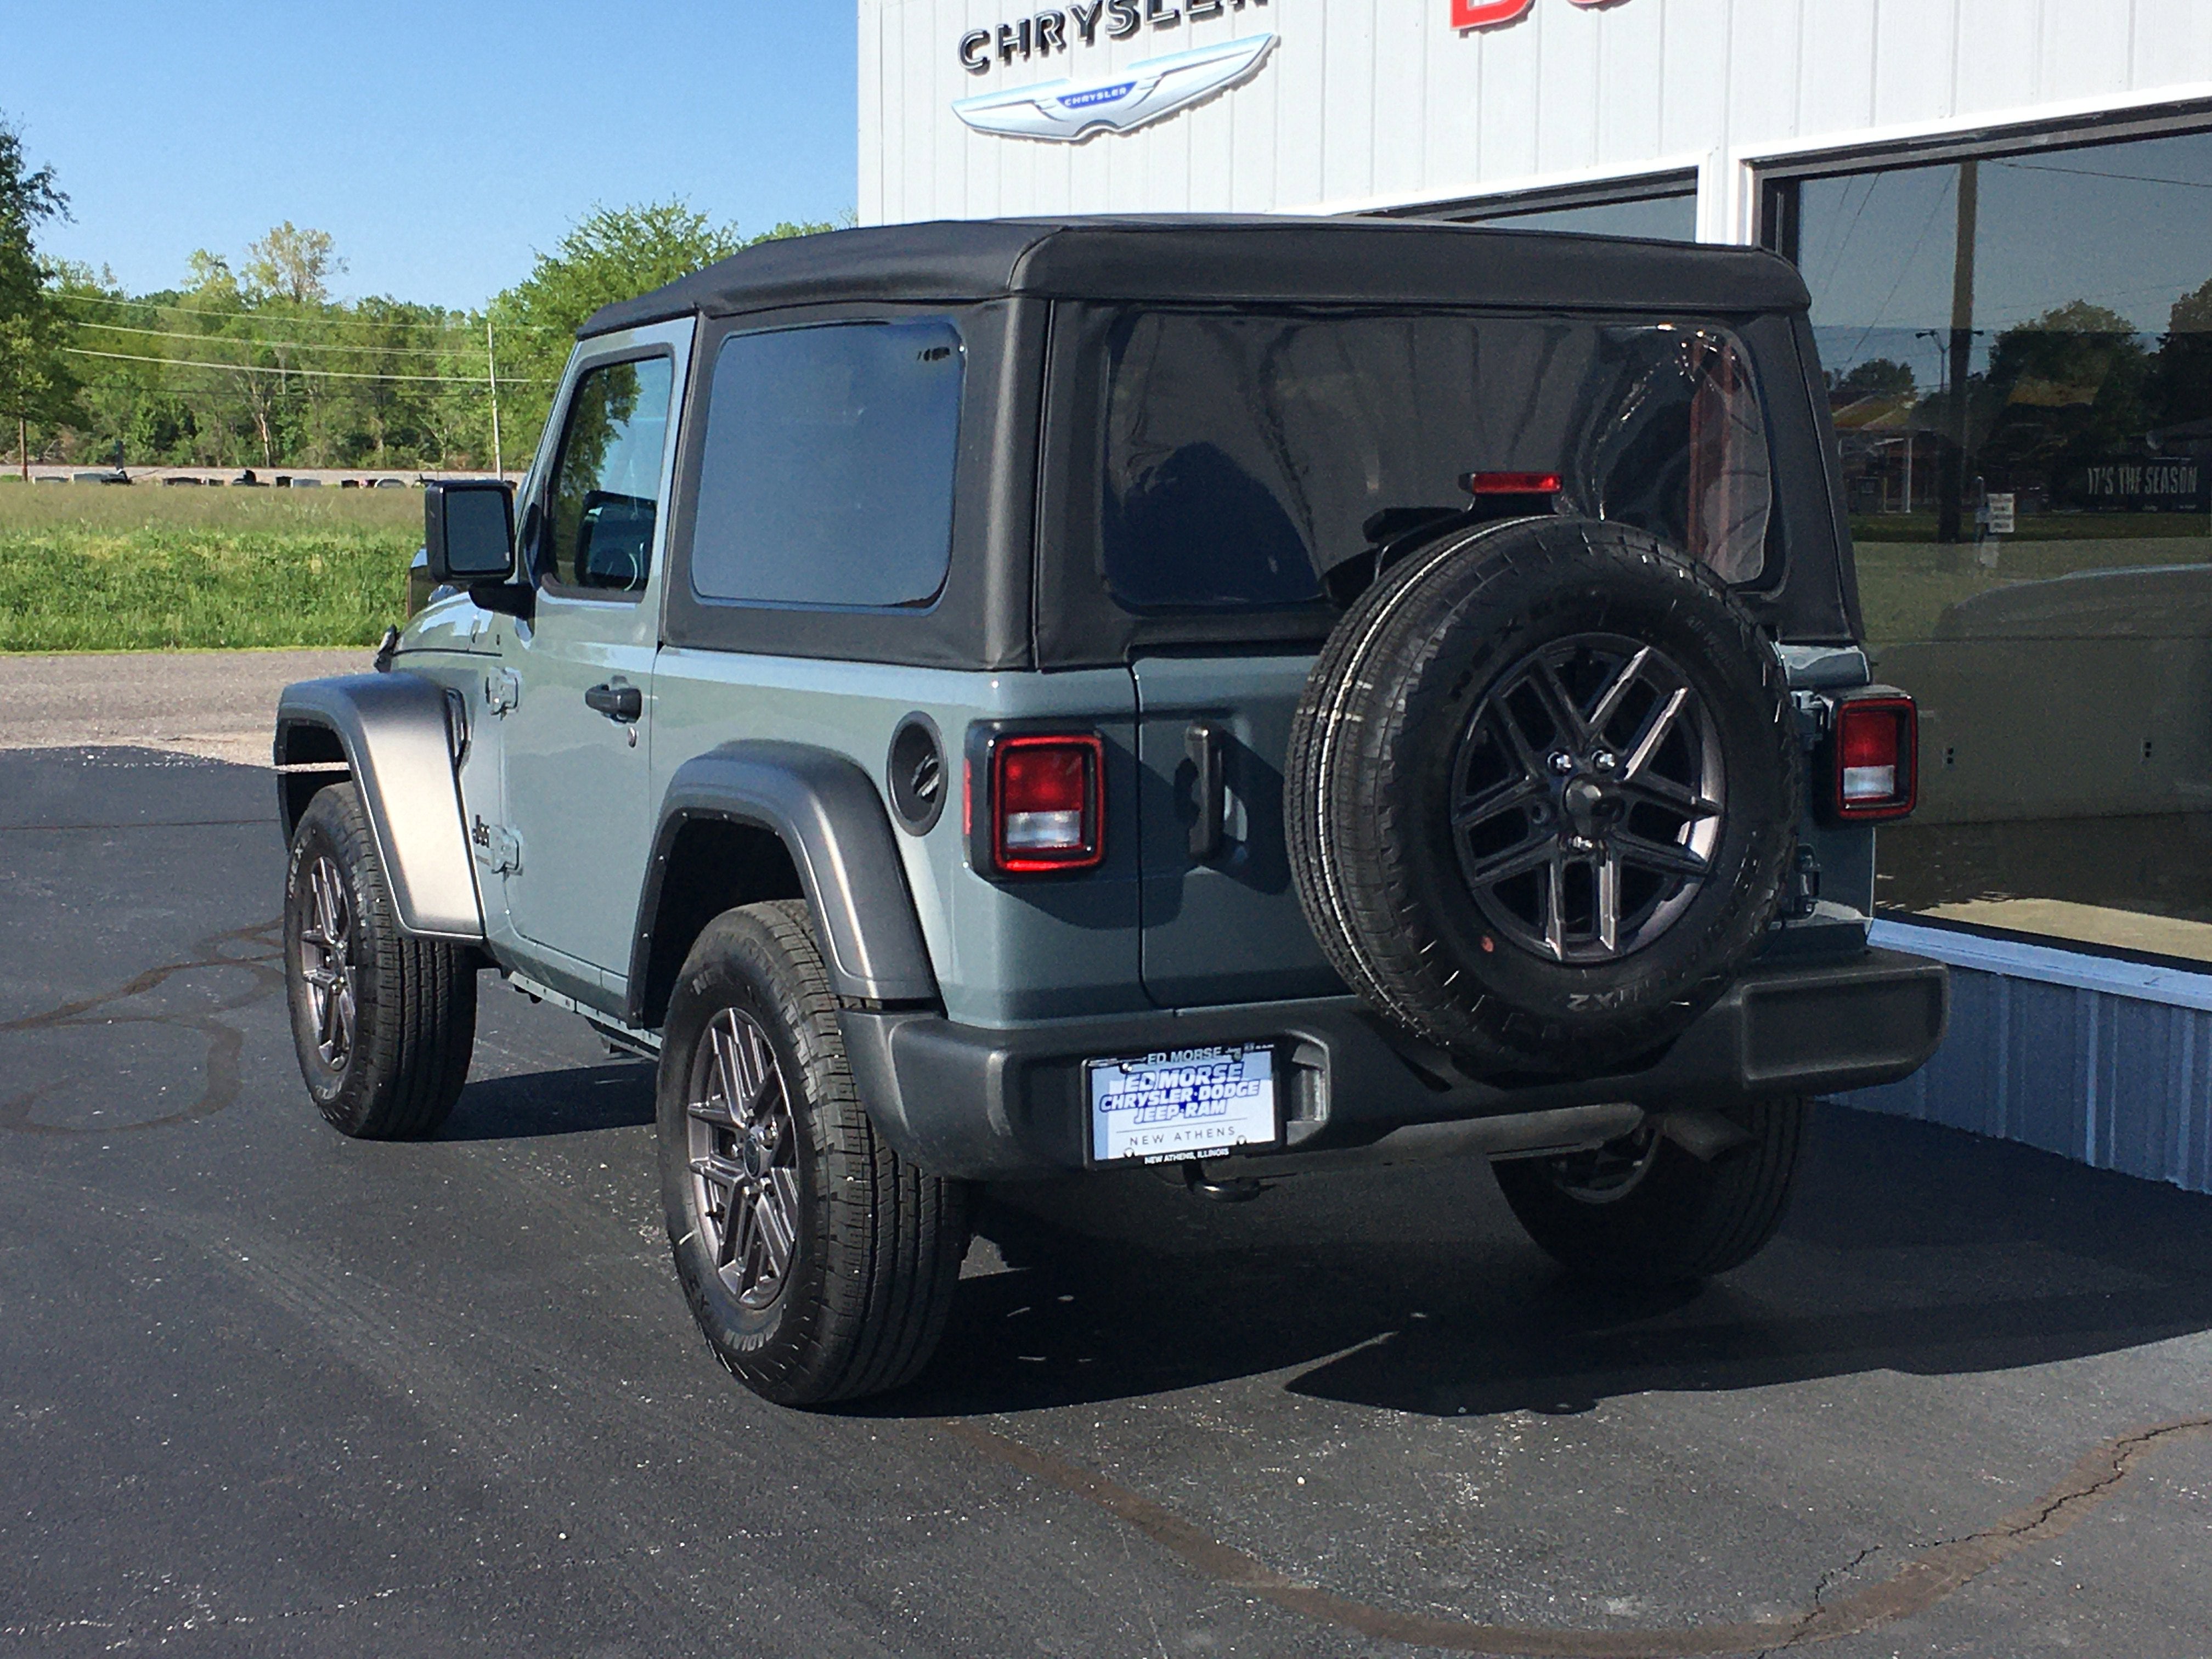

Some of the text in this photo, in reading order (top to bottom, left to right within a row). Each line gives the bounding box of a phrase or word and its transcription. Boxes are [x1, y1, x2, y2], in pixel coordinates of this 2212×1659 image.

[958, 0, 1264, 69] CHRYSL
[1064, 87, 1126, 106] CHRYSLER
[2145, 466, 2197, 494] SEASON
[1147, 1052, 1166, 1065] ED
[1170, 1046, 1222, 1063] MORSE
[1124, 1063, 1244, 1093] ED MORSE
[1130, 1126, 1235, 1146] NEW ATHENS
